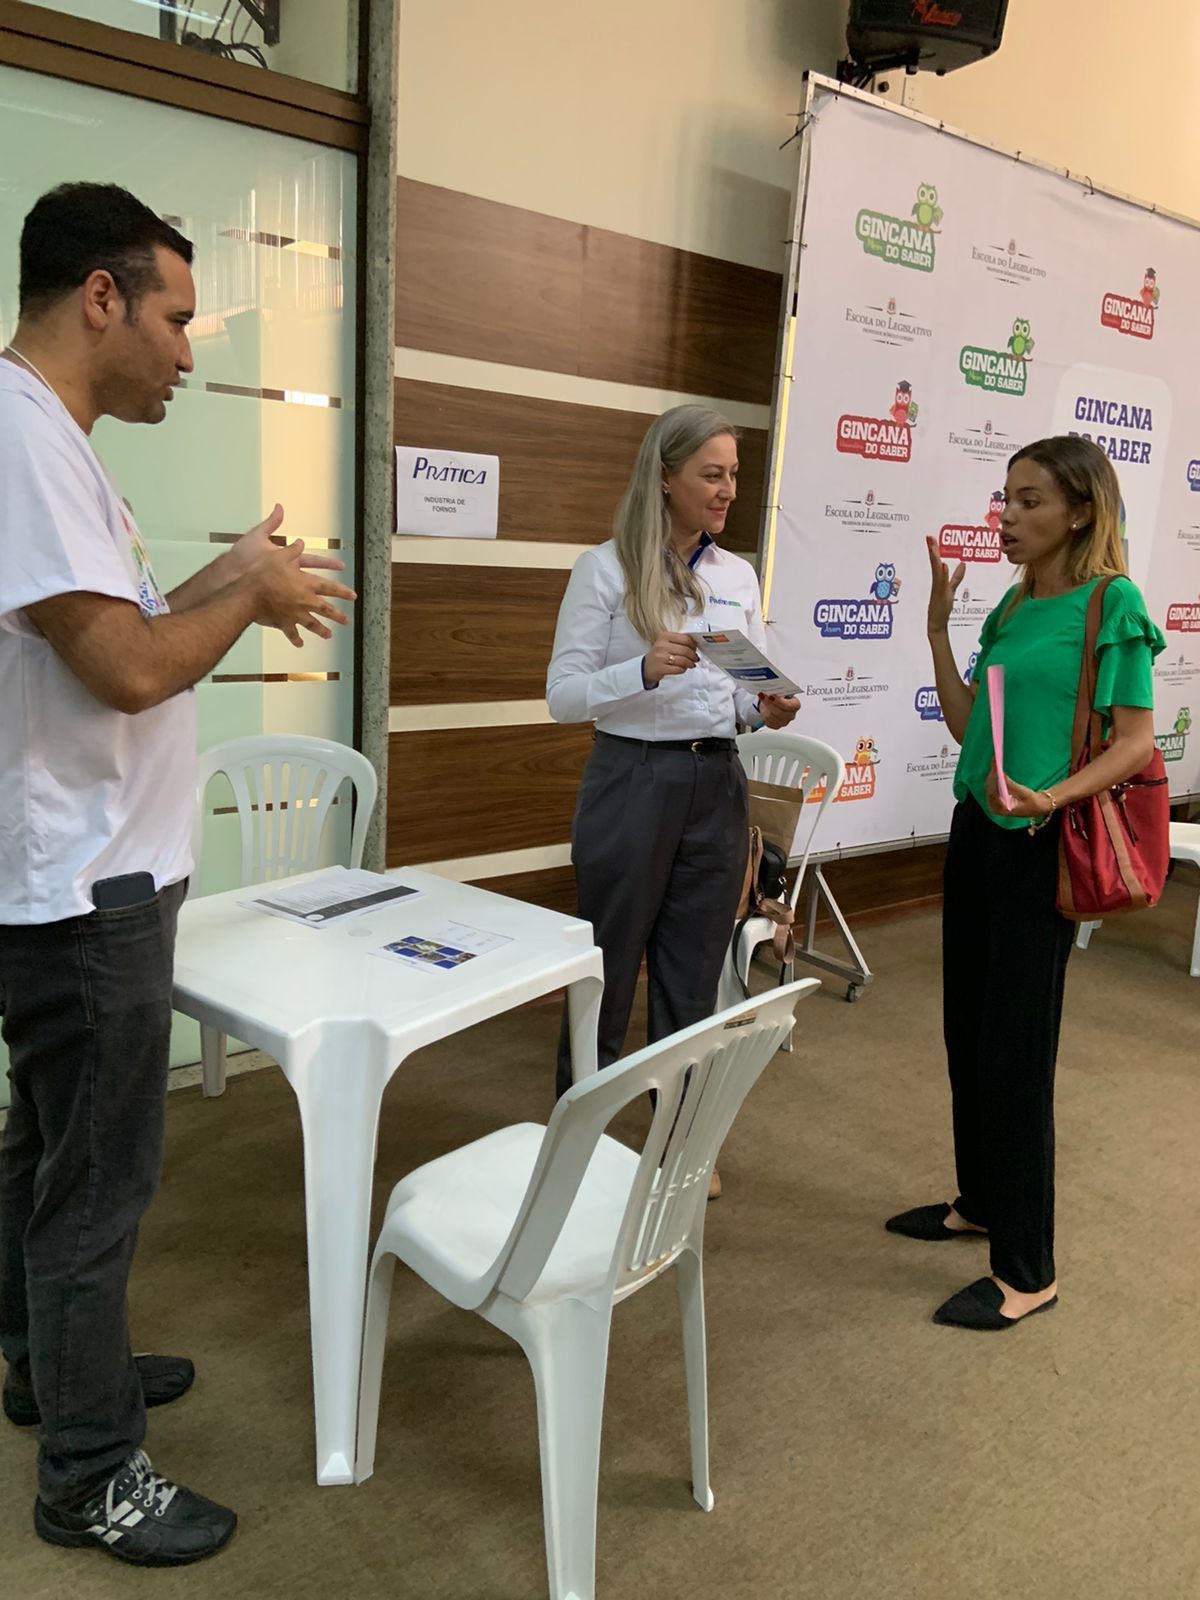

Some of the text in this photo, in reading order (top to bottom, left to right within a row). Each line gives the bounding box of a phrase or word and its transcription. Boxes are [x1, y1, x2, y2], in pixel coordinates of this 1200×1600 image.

[859, 214, 933, 254] GINCANA
[886, 244, 899, 258] DO
[901, 248, 932, 268] SABER
[1104, 297, 1152, 325] GINCANA
[962, 350, 1025, 380] GINCANA
[984, 374, 996, 387] DO
[997, 377, 1024, 392] SABER
[1075, 396, 1153, 431] GINCANA
[840, 419, 909, 446] GINCANA
[865, 442, 878, 454] DO
[879, 444, 908, 458] SABER
[942, 529, 1000, 547] GINCANA
[962, 547, 973, 557] DO
[974, 548, 1000, 559] SABER
[817, 604, 890, 623] GINCANA
[843, 624, 857, 635] DO
[859, 624, 890, 635] SABER
[841, 784, 872, 798] SABER
